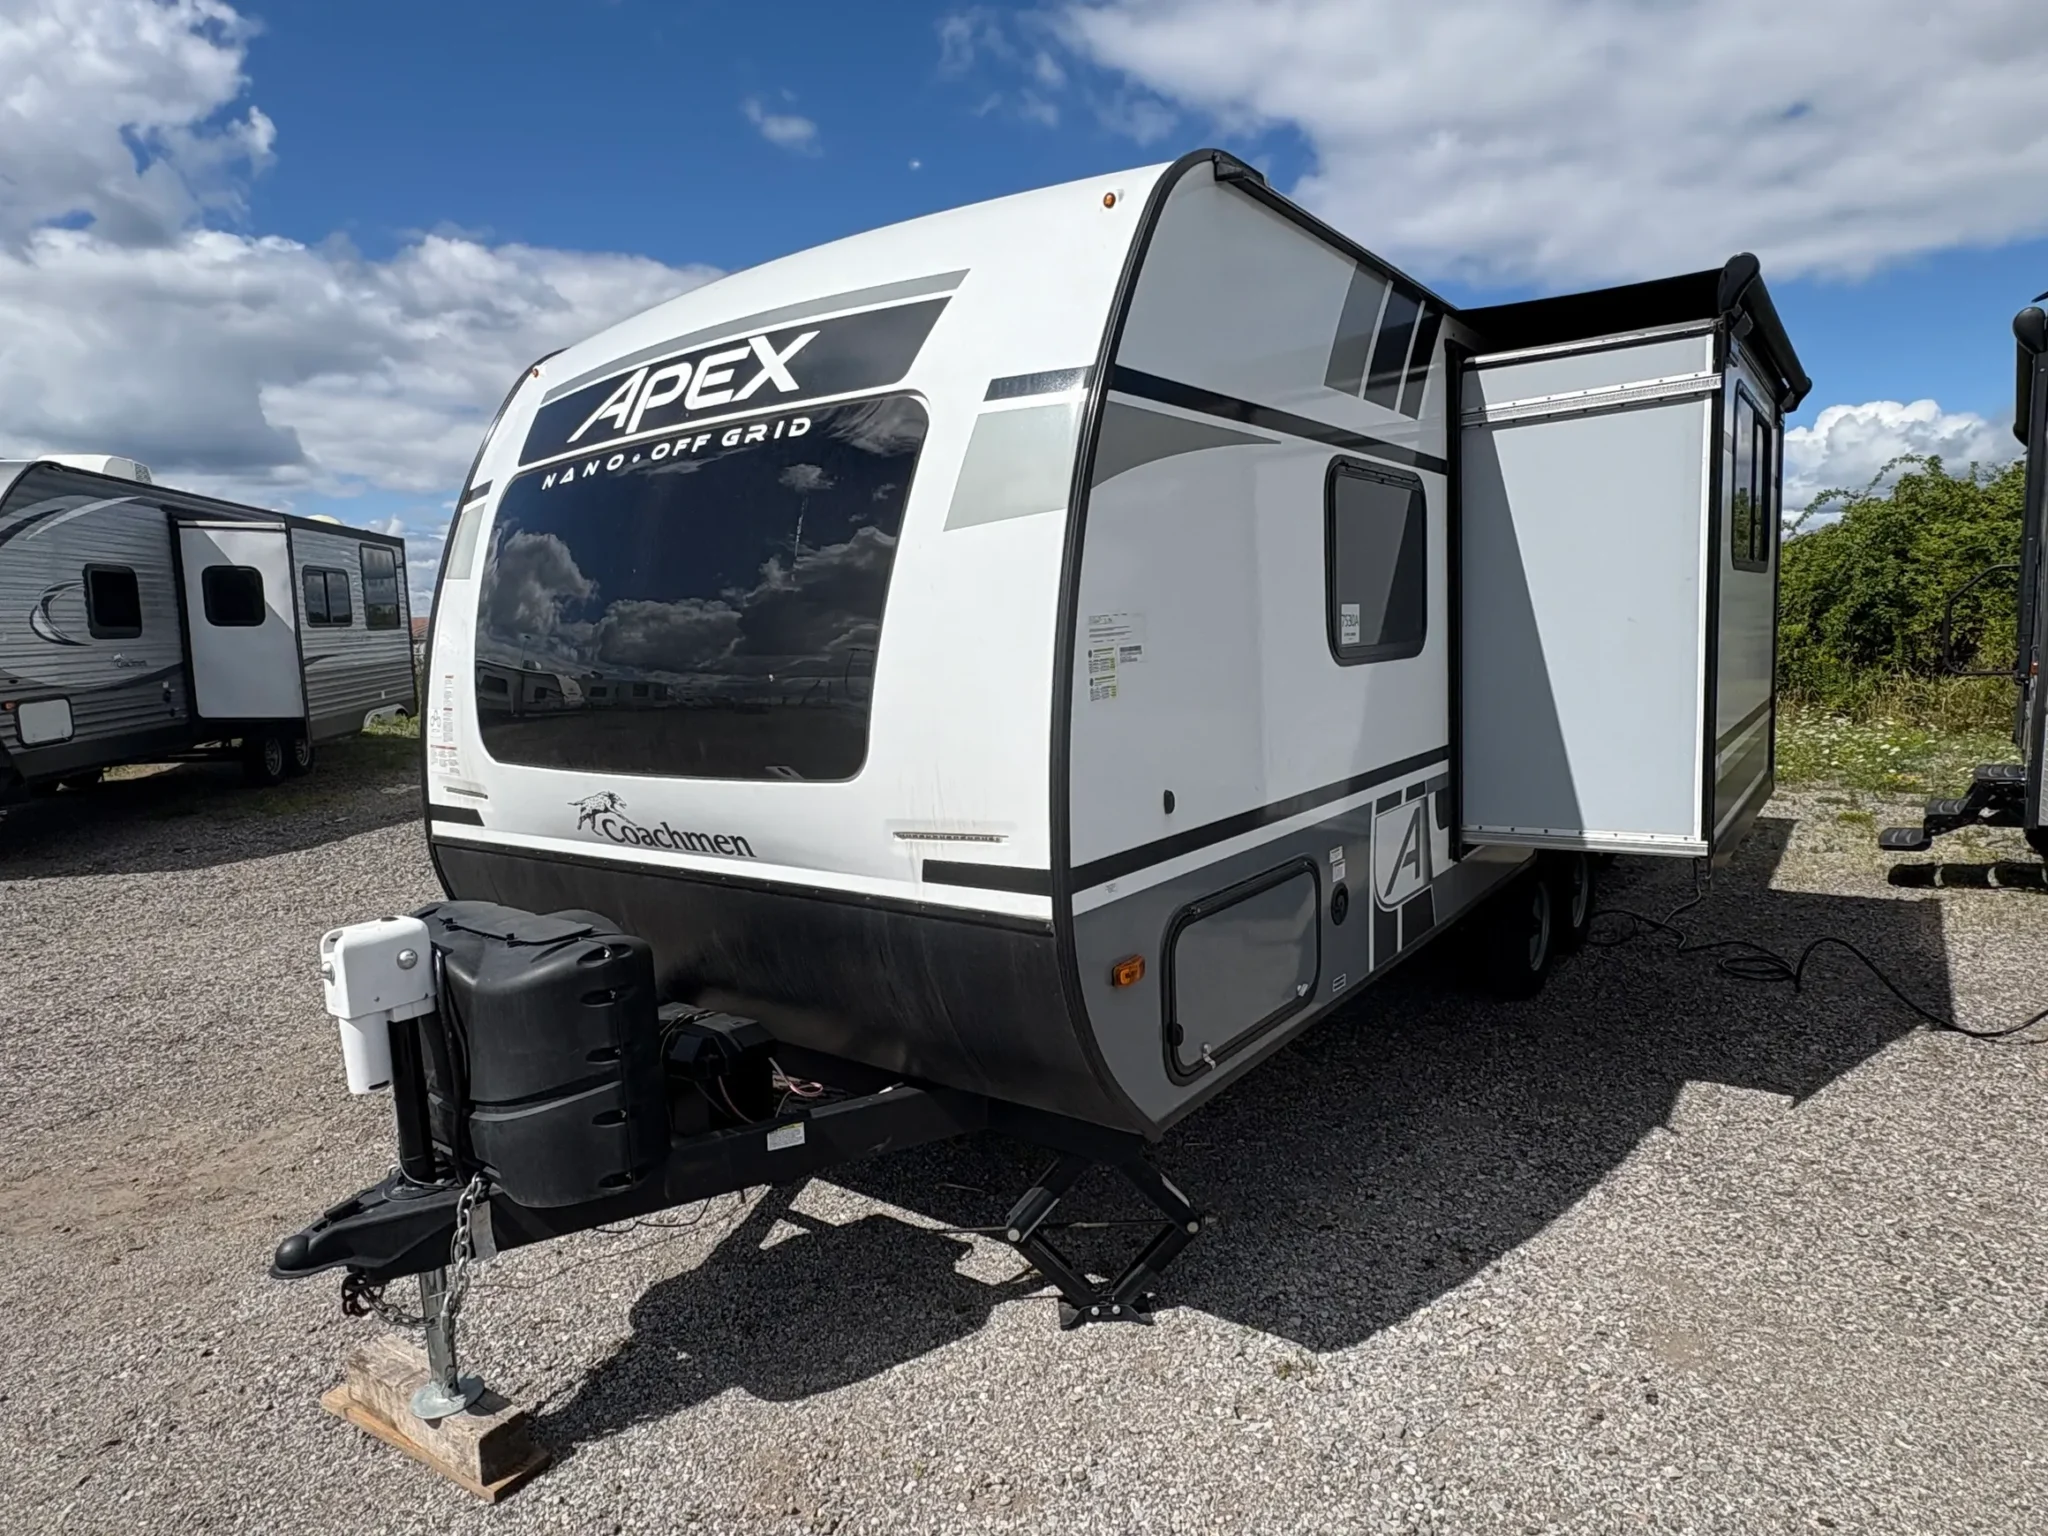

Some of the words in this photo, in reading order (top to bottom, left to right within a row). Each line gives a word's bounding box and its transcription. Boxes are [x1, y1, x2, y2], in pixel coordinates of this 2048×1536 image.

[567, 330, 821, 443] APEX
[541, 453, 624, 490] NANO
[651, 433, 712, 460] OFF
[721, 417, 812, 447] GRID
[602, 818, 757, 858] Coachmen
